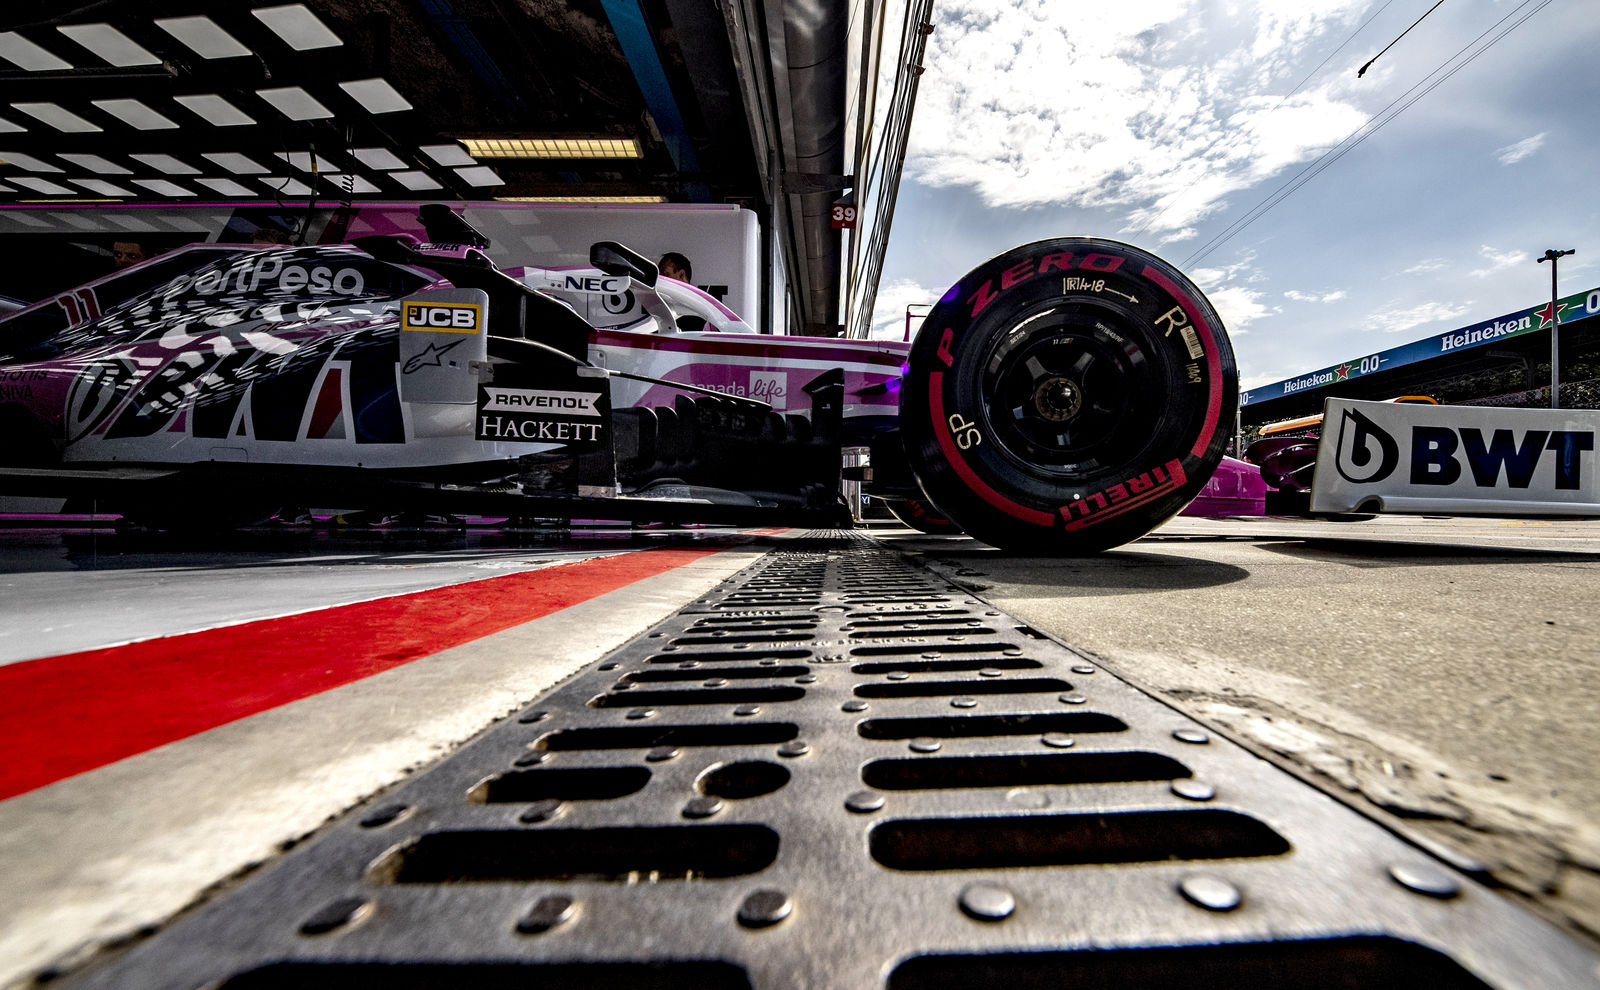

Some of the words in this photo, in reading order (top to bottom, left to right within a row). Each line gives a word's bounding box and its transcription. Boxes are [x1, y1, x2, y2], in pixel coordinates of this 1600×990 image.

[832, 206, 856, 221] 39
[565, 276, 618, 292] NEC
[57, 287, 101, 330] 11
[409, 307, 474, 328] JCB
[936, 328, 954, 367] P
[966, 251, 1126, 318] ZERO
[1154, 305, 1187, 338] R
[1441, 315, 1532, 352] Heineken
[750, 379, 787, 404] life
[1284, 371, 1333, 394] Heineken
[1360, 355, 1379, 375] 0.0
[495, 394, 588, 409] RAVENOL
[480, 415, 602, 442] HACKETT
[949, 413, 982, 450] SP
[1410, 425, 1595, 490] BWT
[1060, 458, 1187, 531] PIRELLI
